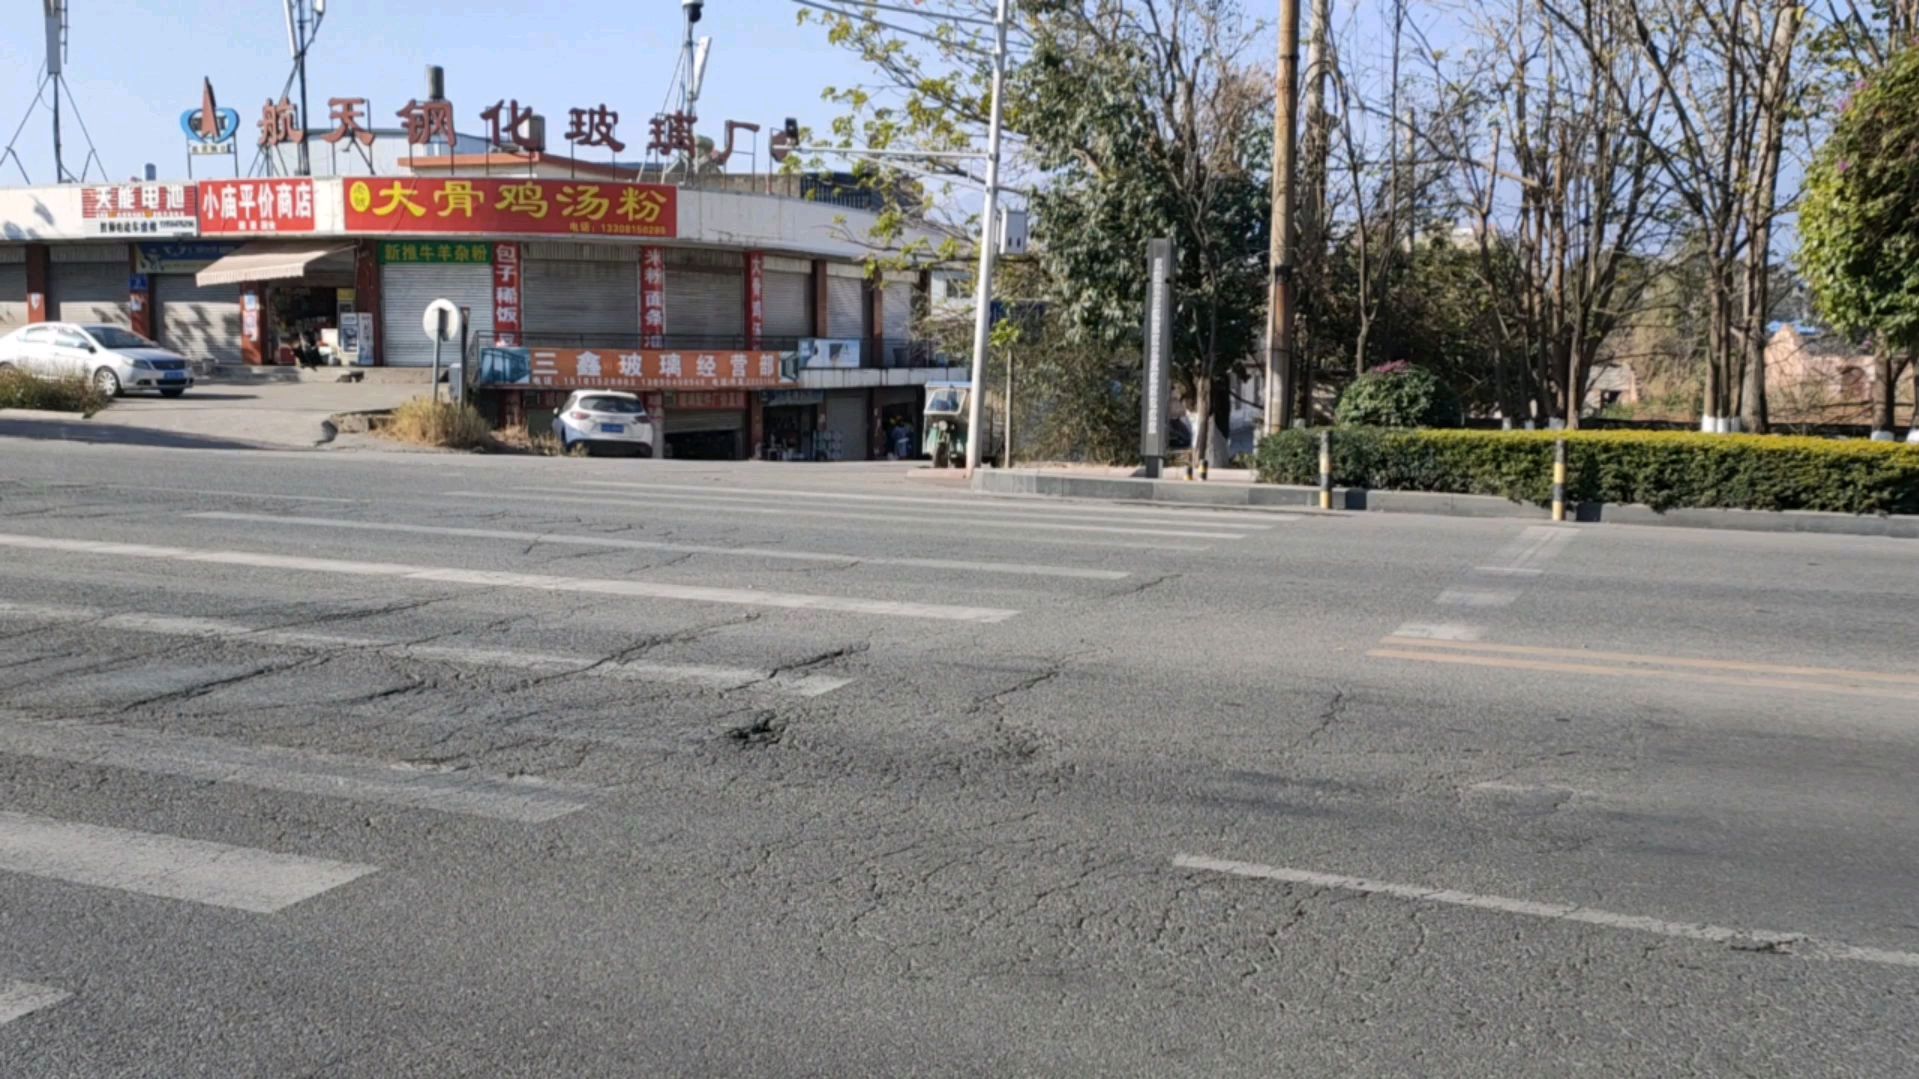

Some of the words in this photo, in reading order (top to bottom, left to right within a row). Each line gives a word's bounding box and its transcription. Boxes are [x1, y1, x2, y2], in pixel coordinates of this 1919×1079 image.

[257, 97, 760, 166] 航天钢化玻璃厂
[95, 185, 185, 209] 天能电池
[202, 181, 312, 220] 小庙平价商店
[372, 180, 667, 223] 大骨鸡汤粉
[532, 350, 775, 378] 三鑫玻璃经营部
